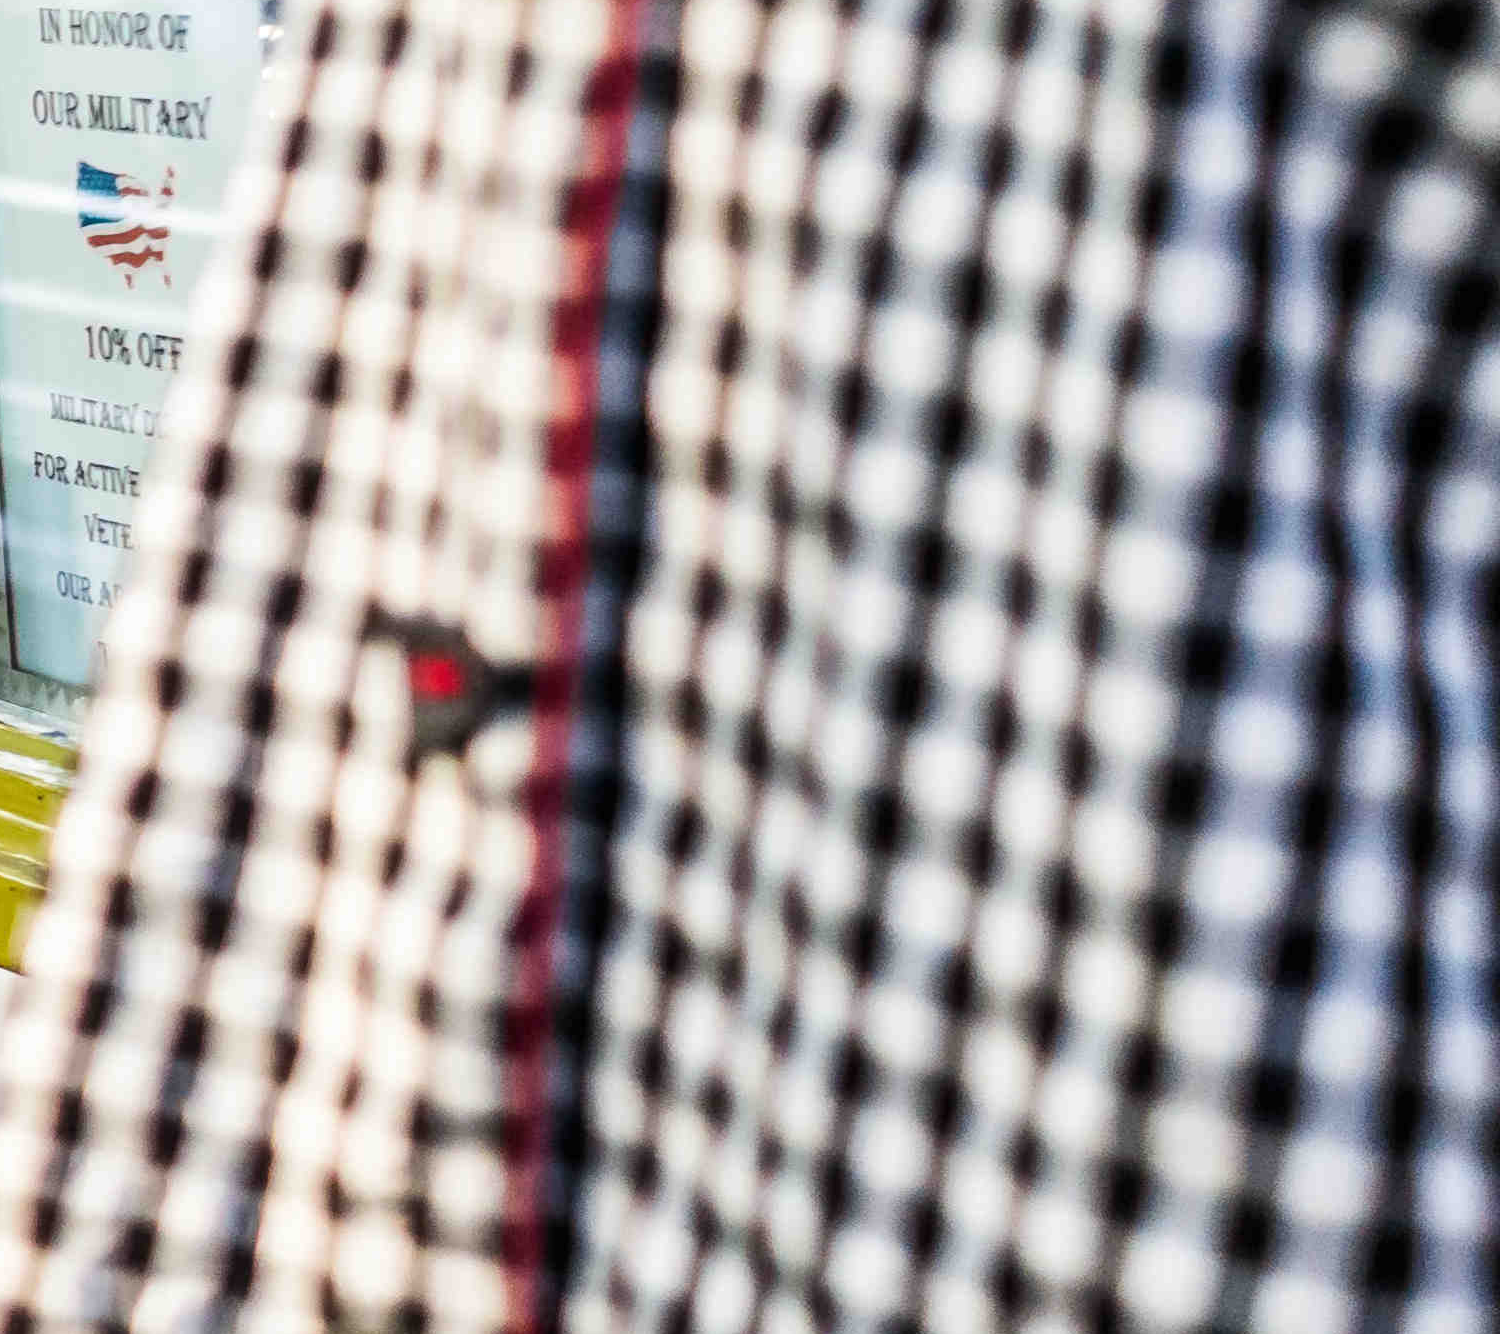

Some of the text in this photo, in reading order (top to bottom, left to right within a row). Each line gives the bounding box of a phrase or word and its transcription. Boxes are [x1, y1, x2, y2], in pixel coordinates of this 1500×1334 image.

[38, 7, 192, 53] IN HONOR OF
[32, 89, 212, 140] OUR MILITARY
[84, 324, 184, 372] 10% OFF
[50, 392, 140, 435] MILITARY
[33, 451, 141, 498] FOR ACTIVE
[84, 513, 138, 550] VETE
[56, 570, 94, 605] OUR
